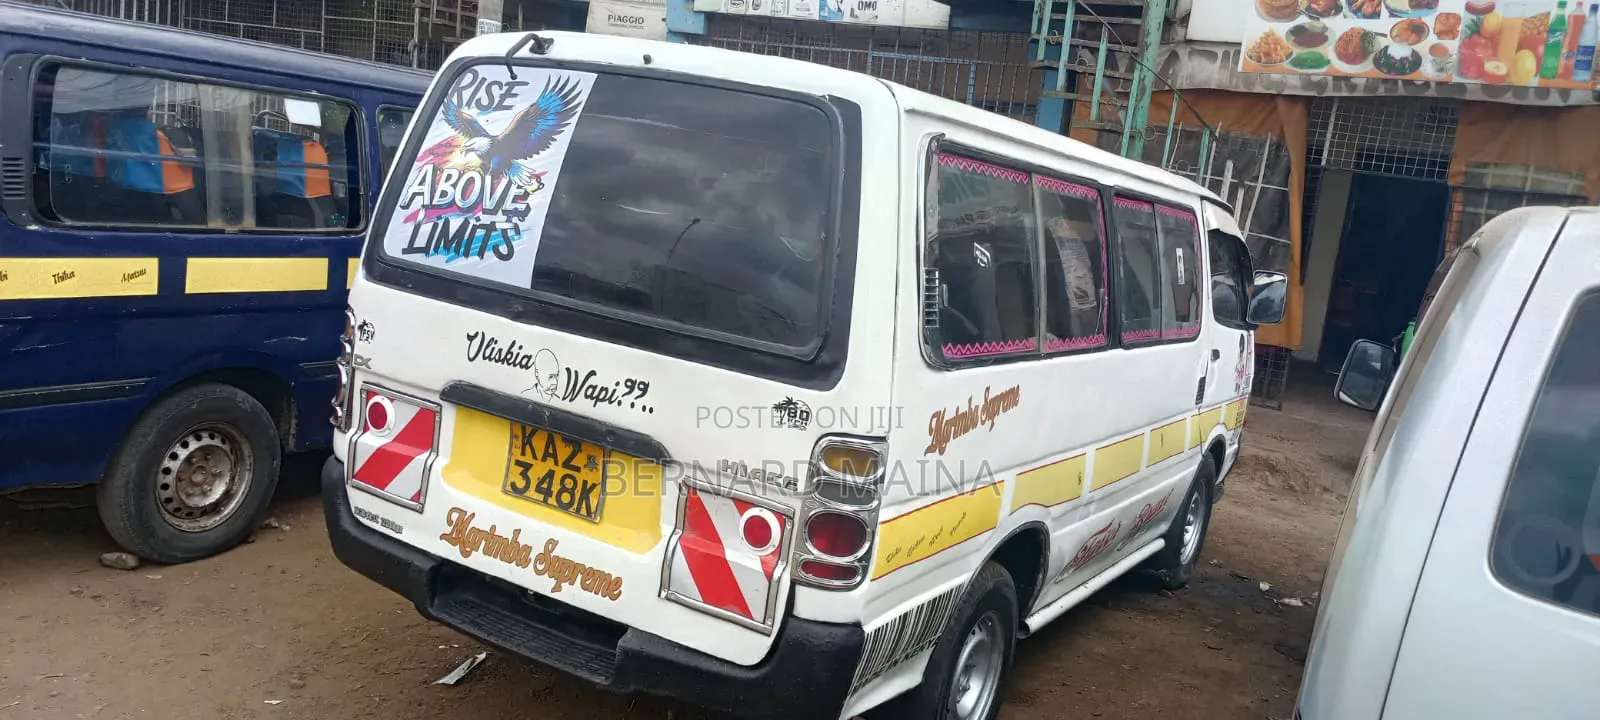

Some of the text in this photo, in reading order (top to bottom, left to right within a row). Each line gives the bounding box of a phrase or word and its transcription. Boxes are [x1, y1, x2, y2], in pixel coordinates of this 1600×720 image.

[607, 14, 645, 25] PIAGGIO
[450, 67, 530, 112] RISE
[400, 163, 532, 217] ABOVE
[924, 383, 1020, 457] Marimba Supreme
[510, 459, 599, 518] 348K
[440, 506, 533, 569] Marimba
[533, 537, 624, 602] Supreme
